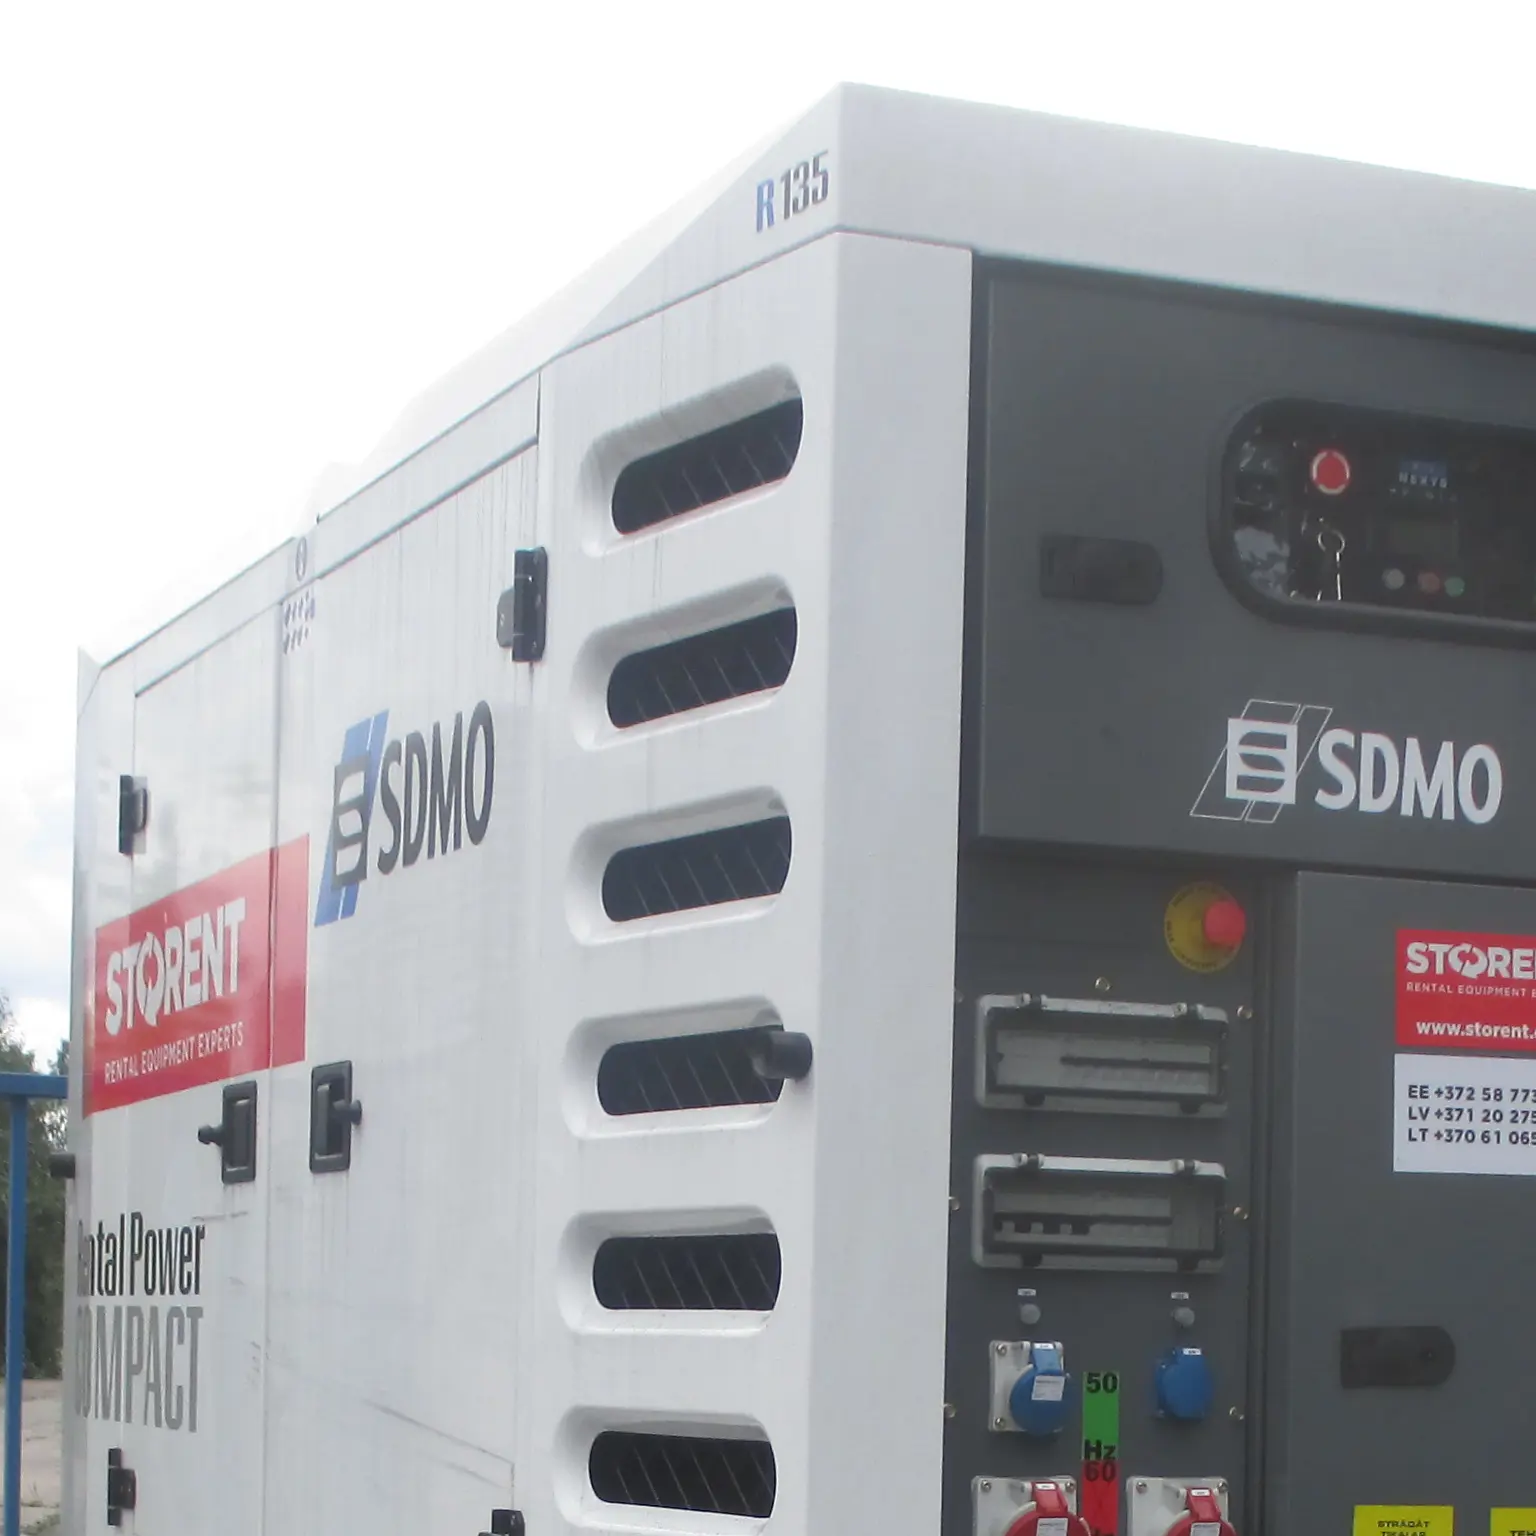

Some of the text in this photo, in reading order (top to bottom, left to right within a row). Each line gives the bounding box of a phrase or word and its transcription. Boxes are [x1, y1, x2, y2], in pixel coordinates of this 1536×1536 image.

[756, 149, 829, 233] R 135
[377, 699, 496, 876] SDMO
[1314, 728, 1503, 824] SDMO
[105, 897, 246, 1036] STORENT
[1406, 981, 1453, 994] RENTAL
[1457, 984, 1526, 998] EQUIPMENT
[104, 1021, 244, 1084] RENTAL EQUIPMENT EXPERTS
[1408, 1084, 1430, 1099] EE
[1434, 1086, 1475, 1101] +372
[1482, 1087, 1503, 1102] 58
[1408, 1106, 1430, 1121] LV
[1434, 1107, 1474, 1122] +371
[1482, 1109, 1503, 1123] 20
[1408, 1128, 1429, 1142] LT
[1434, 1129, 1475, 1143] +370
[1481, 1130, 1501, 1144] 61
[129, 1211, 206, 1296] Power
[1085, 1371, 1119, 1394] 50
[1083, 1439, 1117, 1461] Hz
[1084, 1461, 1117, 1483] 60
